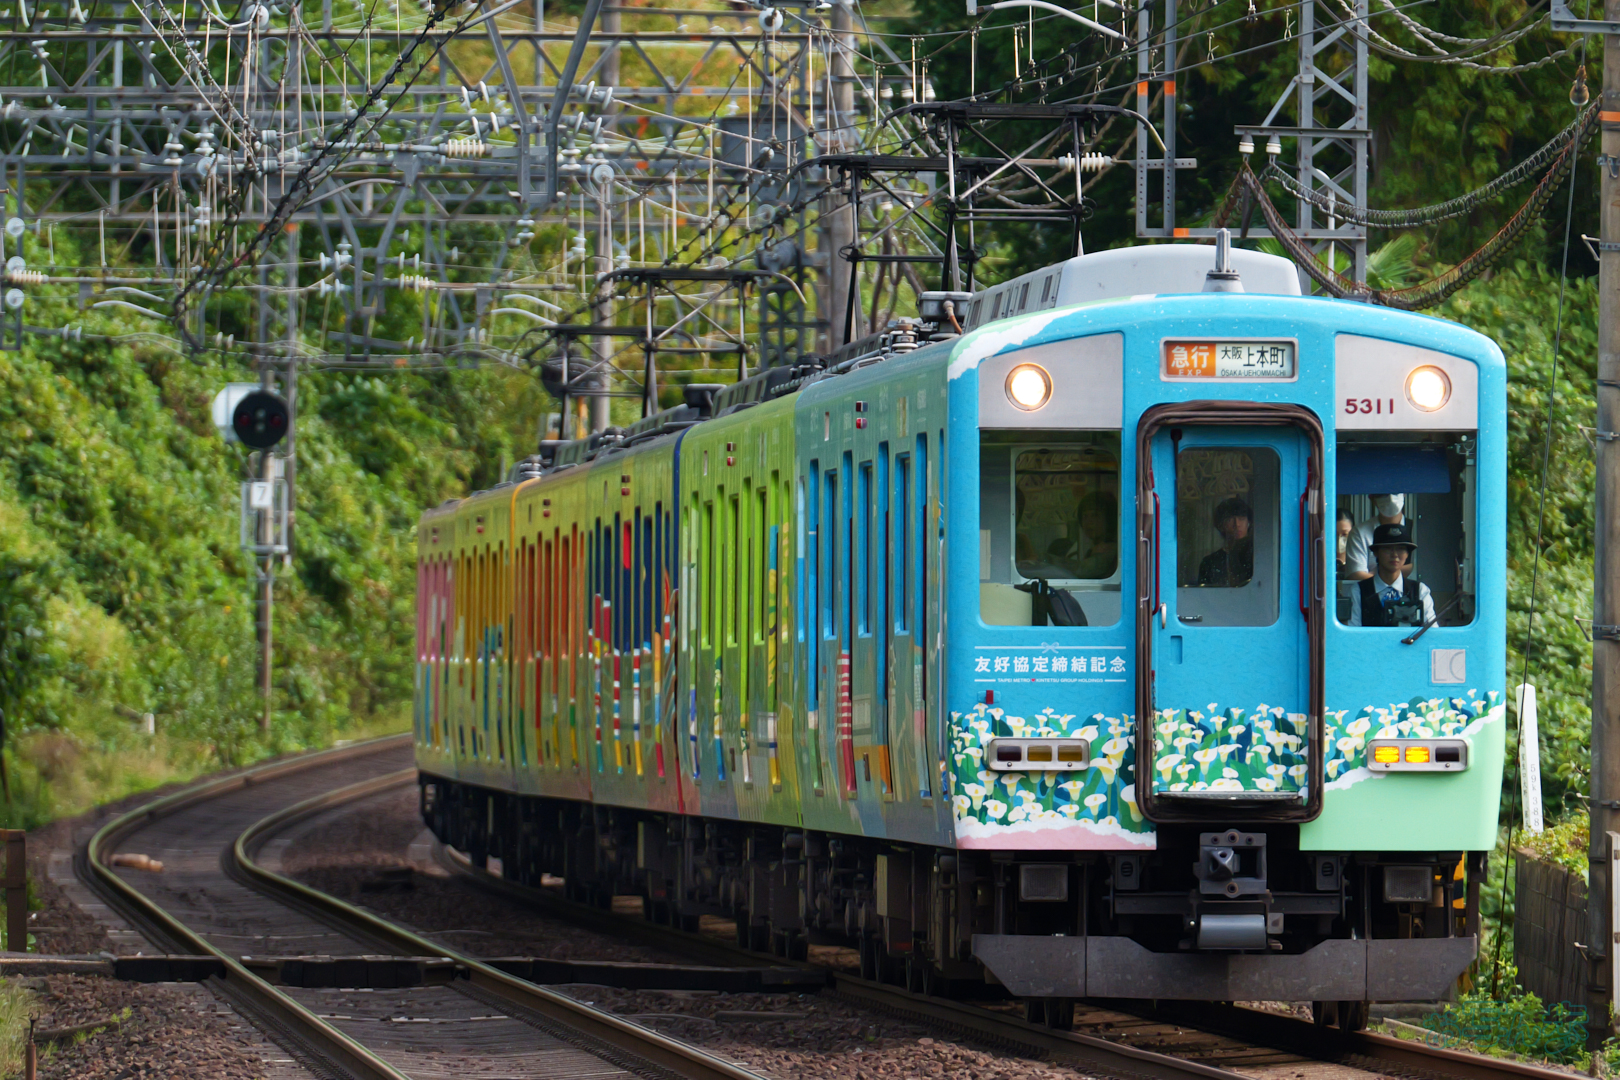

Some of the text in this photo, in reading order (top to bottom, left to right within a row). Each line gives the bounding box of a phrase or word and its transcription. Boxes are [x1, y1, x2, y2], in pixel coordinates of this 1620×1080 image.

[1171, 345, 1210, 369] 急行
[1220, 345, 1287, 368] 大阪上本町
[1344, 398, 1395, 415] 5311
[257, 486, 266, 501] 7
[974, 655, 1127, 673] 友好協定締結記念
